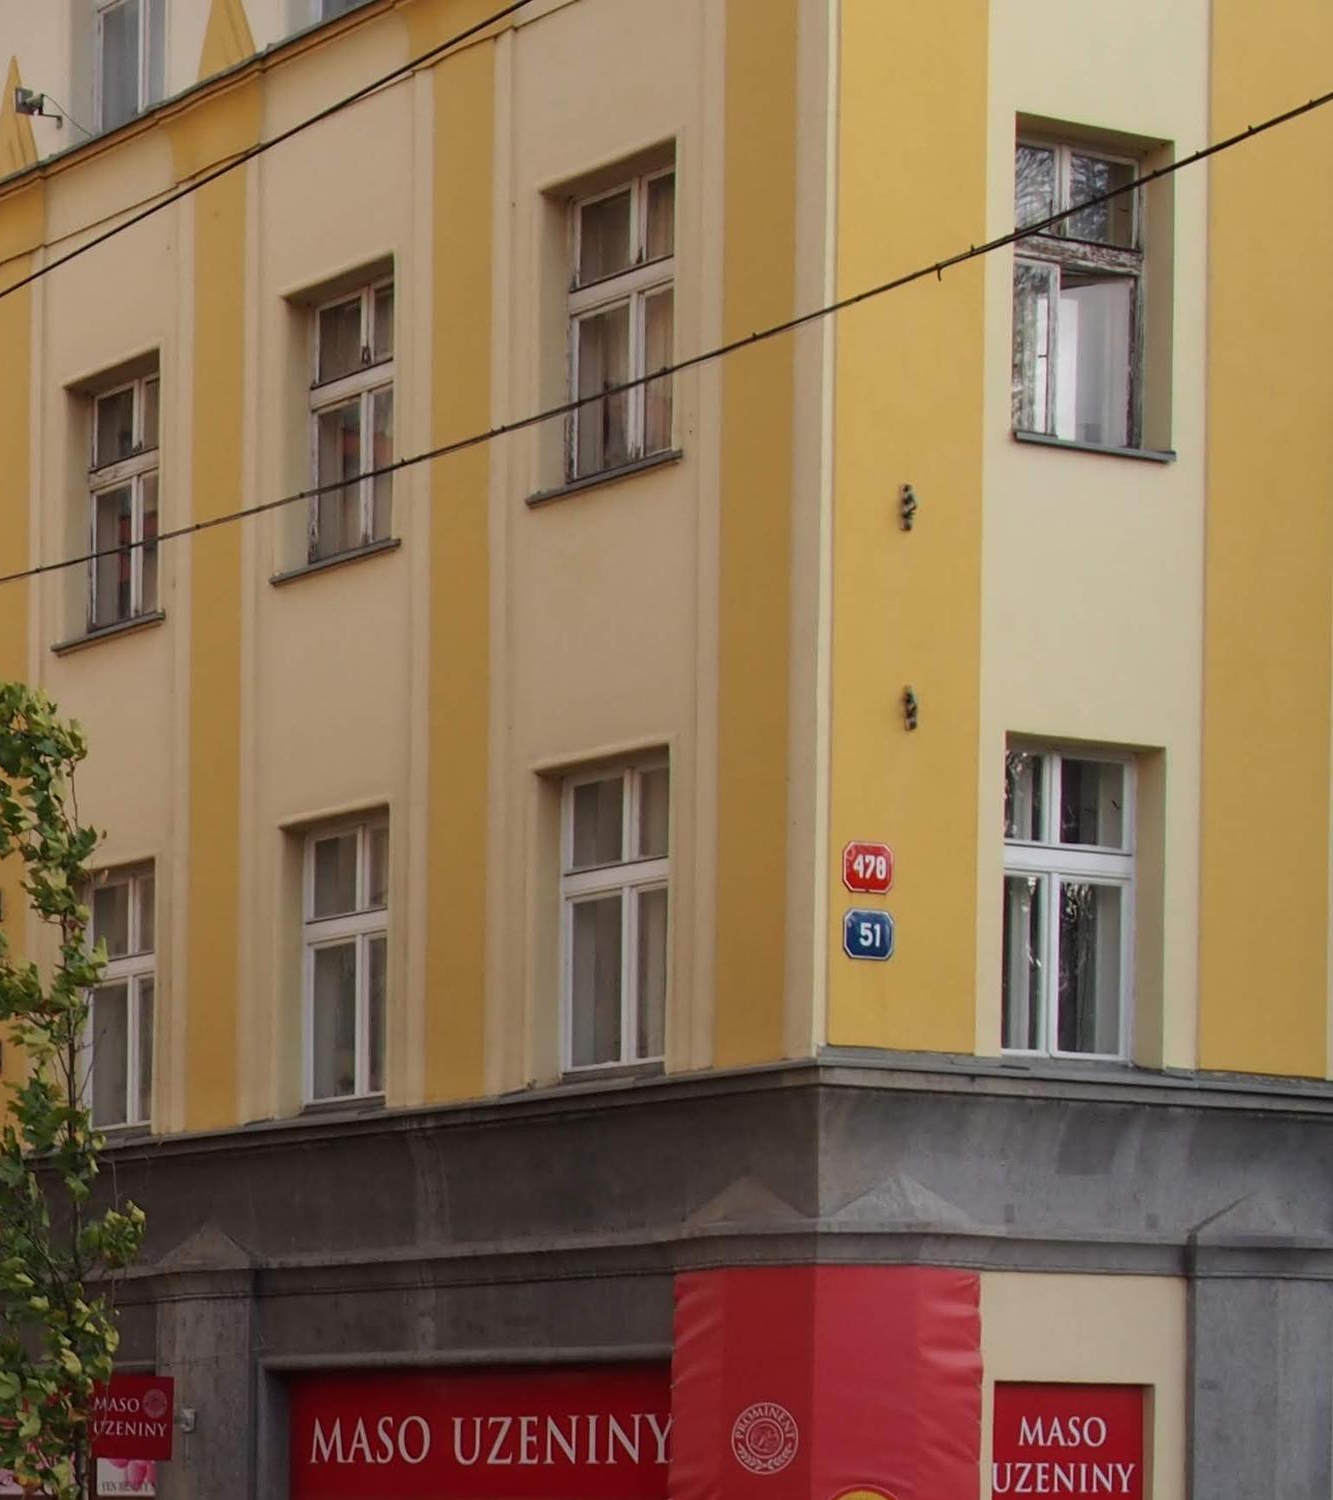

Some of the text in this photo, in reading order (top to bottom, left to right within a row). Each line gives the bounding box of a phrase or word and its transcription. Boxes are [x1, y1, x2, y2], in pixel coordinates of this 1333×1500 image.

[853, 855, 887, 880] 478
[859, 922, 881, 948] 51
[93, 1397, 140, 1413] MASO
[93, 1420, 167, 1438] UZENINY
[734, 1404, 794, 1438] PROMINENT
[1018, 1416, 1107, 1447] MASO
[309, 1413, 672, 1466] MASO UZENINY
[993, 1463, 1135, 1493] UZENINY
